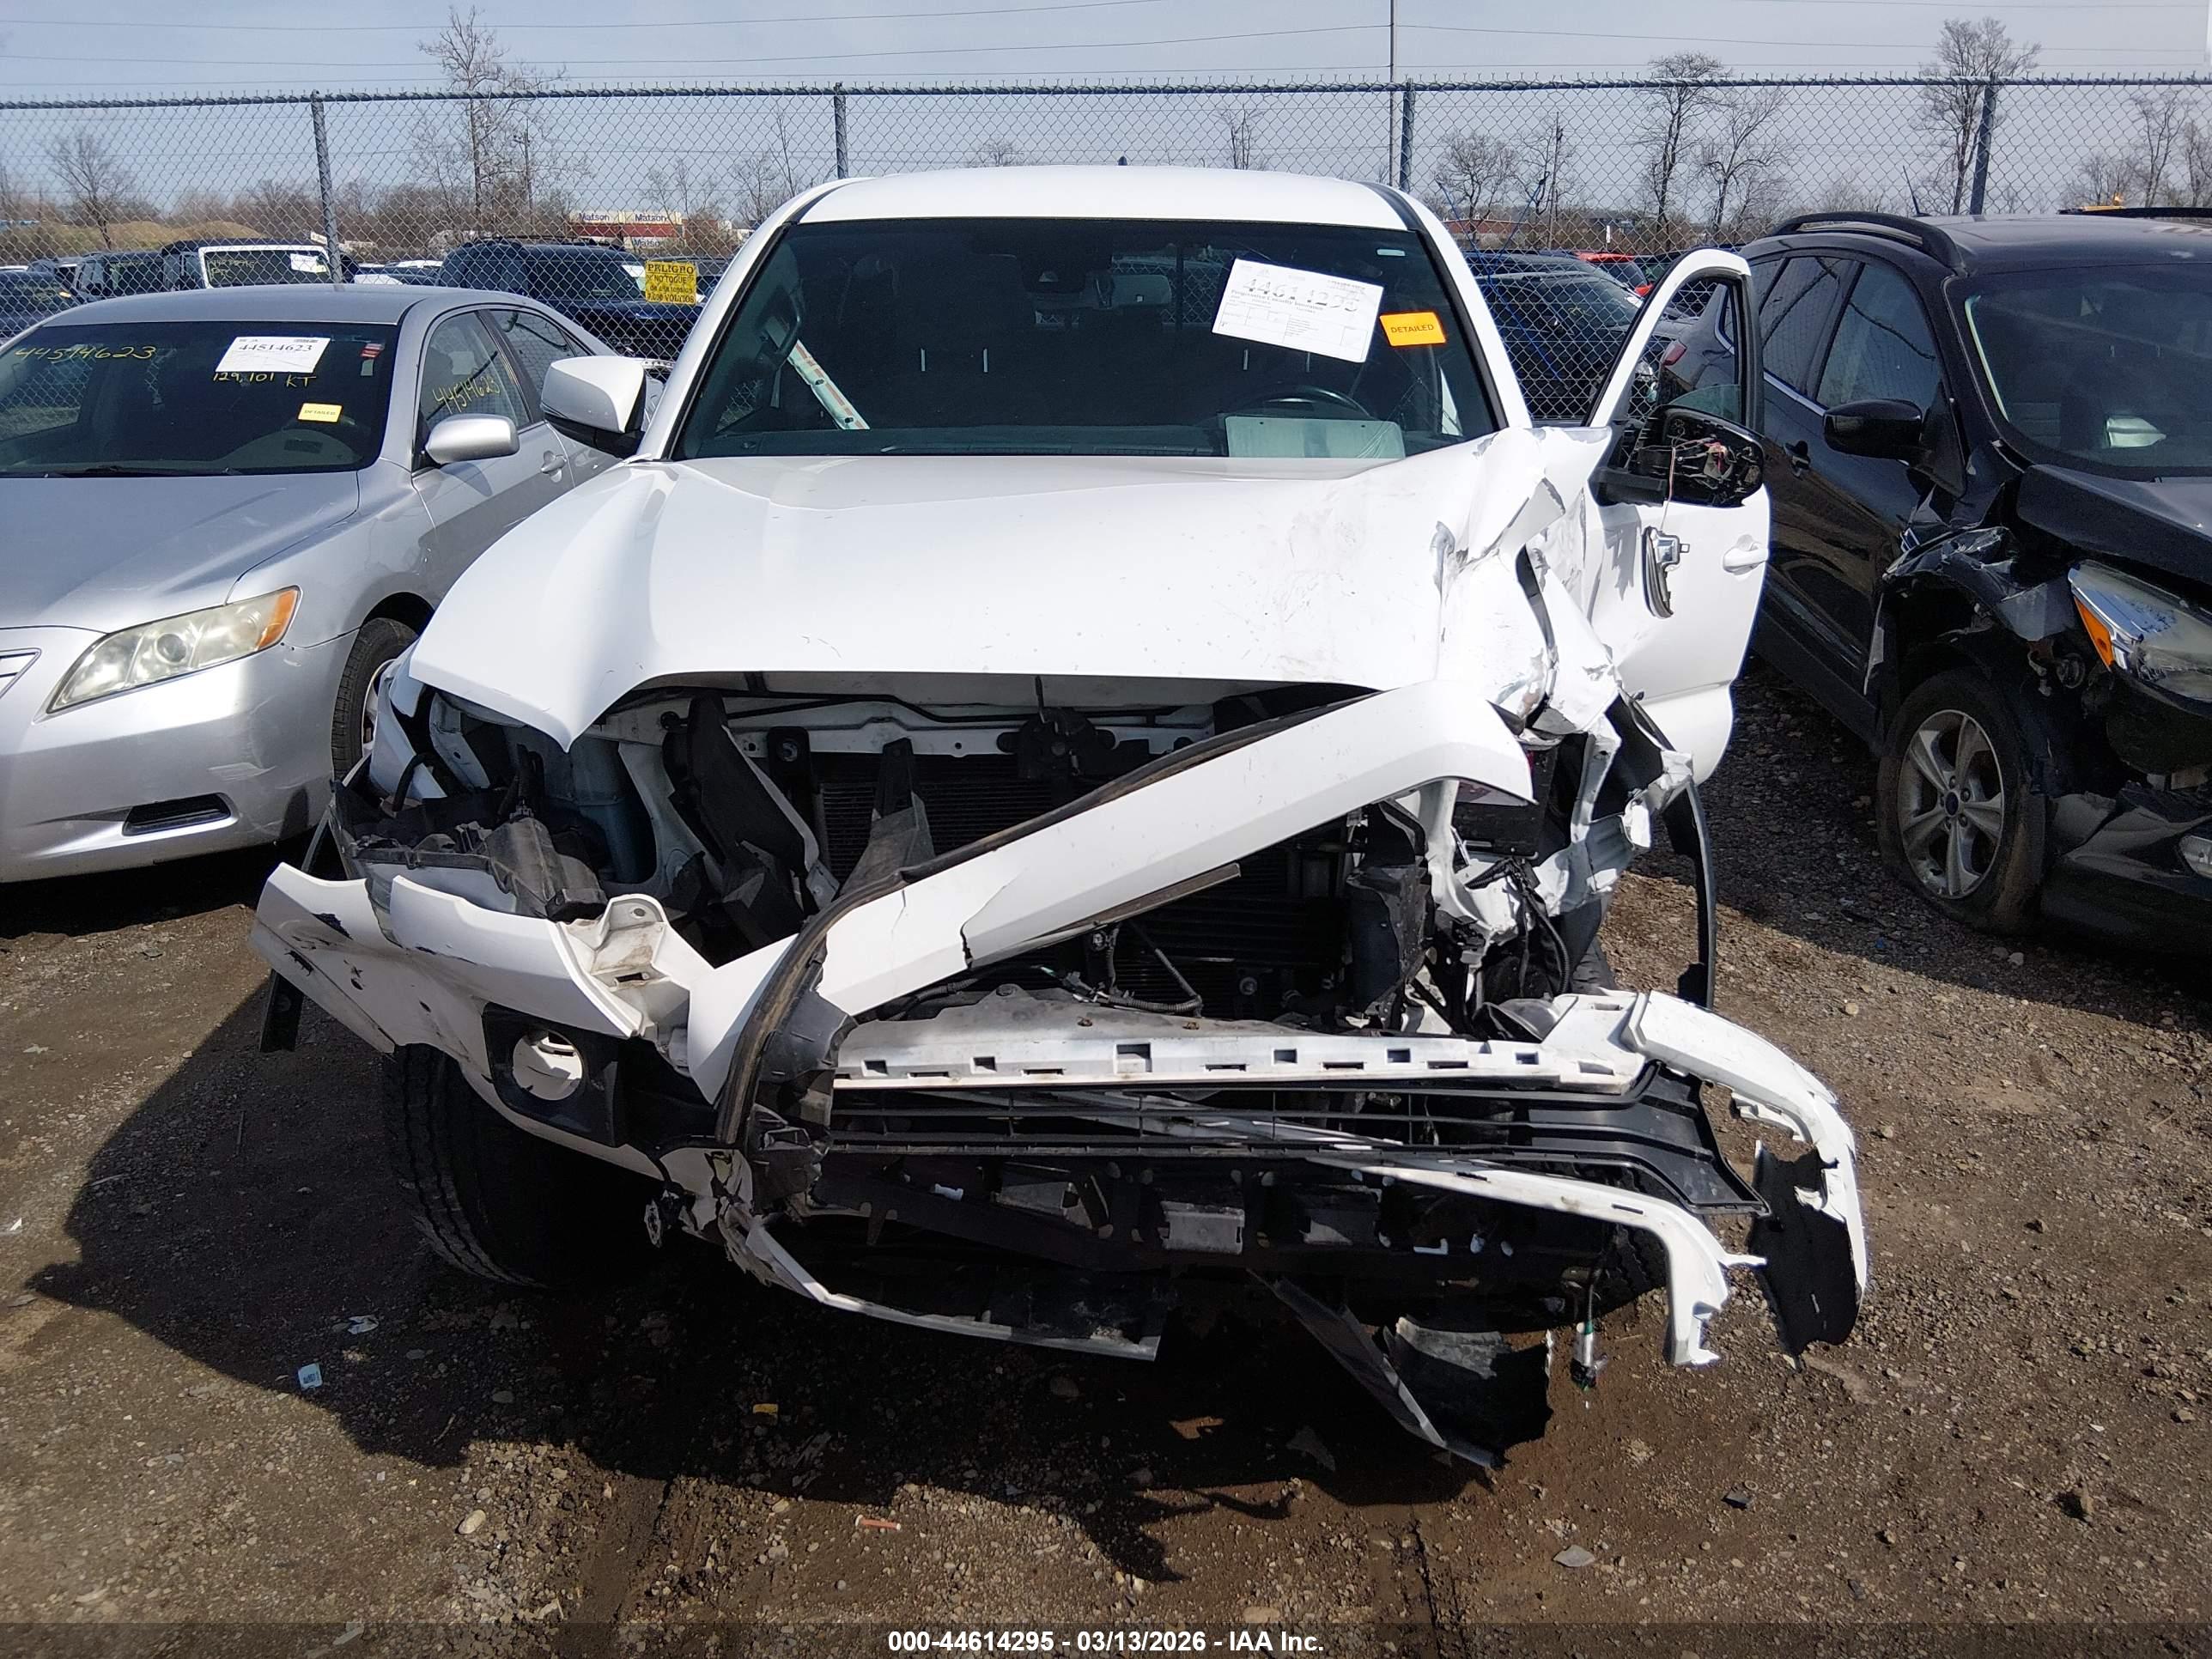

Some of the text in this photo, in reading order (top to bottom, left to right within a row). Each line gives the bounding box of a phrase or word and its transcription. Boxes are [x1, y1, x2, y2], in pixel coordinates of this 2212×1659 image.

[579, 213, 610, 222] Matson
[635, 213, 667, 222] Matson
[633, 238, 660, 247] Matso
[647, 264, 694, 275] PELIGRO
[665, 276, 688, 284] TOQUE
[1390, 324, 1435, 333] DETAILED
[238, 343, 313, 352] 44514623
[15, 346, 157, 361] 44514623
